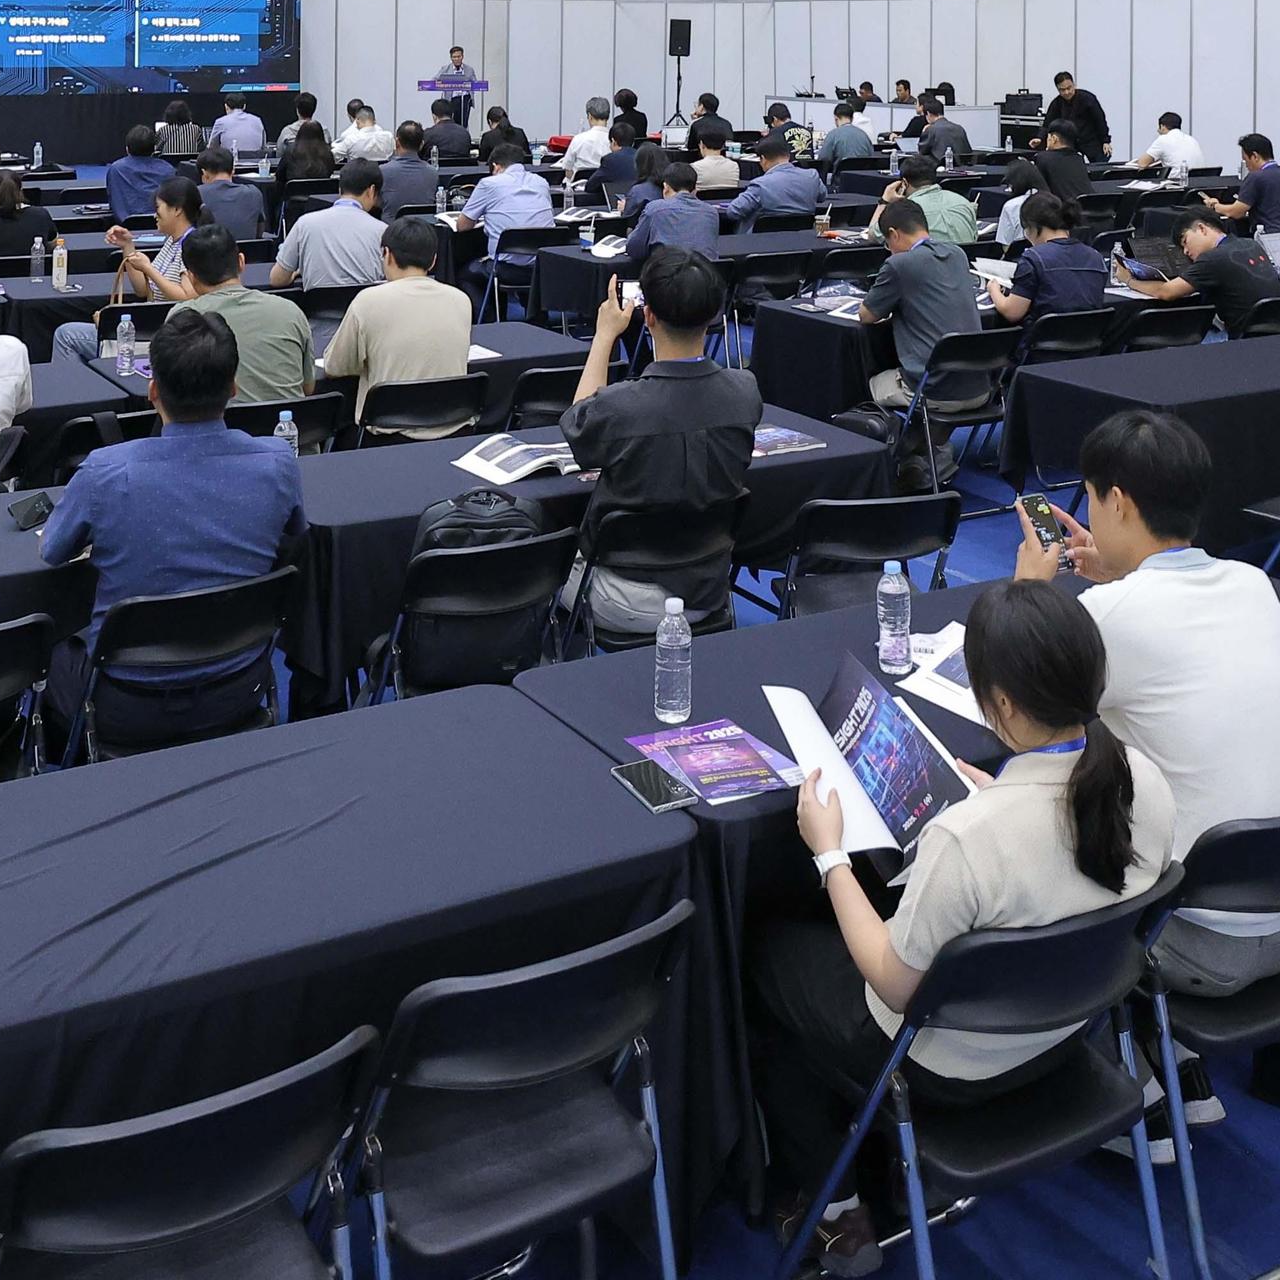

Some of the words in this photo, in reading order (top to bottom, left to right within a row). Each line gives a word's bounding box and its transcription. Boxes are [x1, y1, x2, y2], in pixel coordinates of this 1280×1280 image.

[704, 726, 744, 740] 2025
[834, 708, 861, 750] SIGHT
[854, 686, 873, 717] 2025
